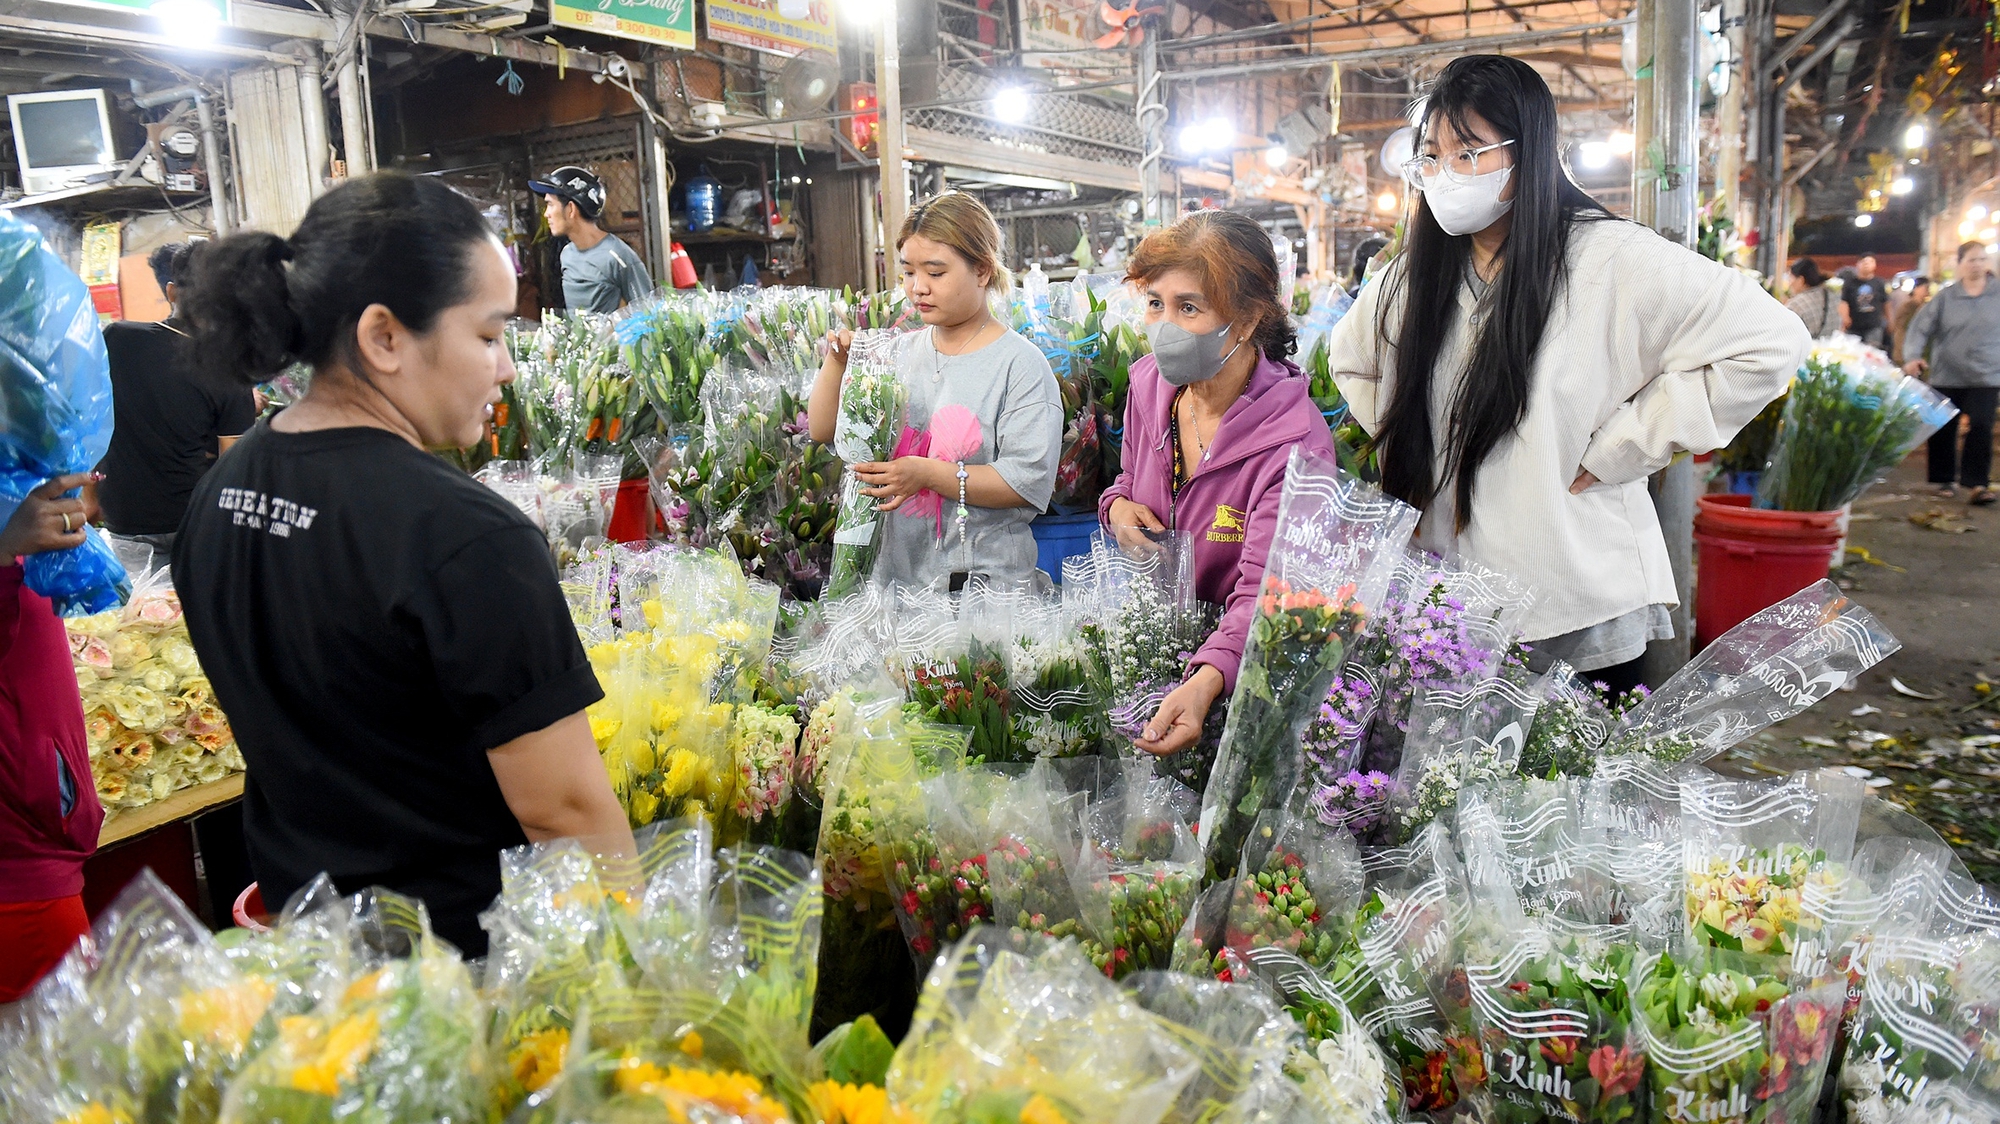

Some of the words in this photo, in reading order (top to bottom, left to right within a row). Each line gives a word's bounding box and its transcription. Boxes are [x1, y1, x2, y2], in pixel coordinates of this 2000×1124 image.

[1206, 530, 1244, 543] BURBERR
[1512, 850, 1575, 889] Kính
[1718, 842, 1793, 880] Kính
[1500, 1048, 1576, 1101] Kính
[1663, 1083, 1752, 1123] Kính
